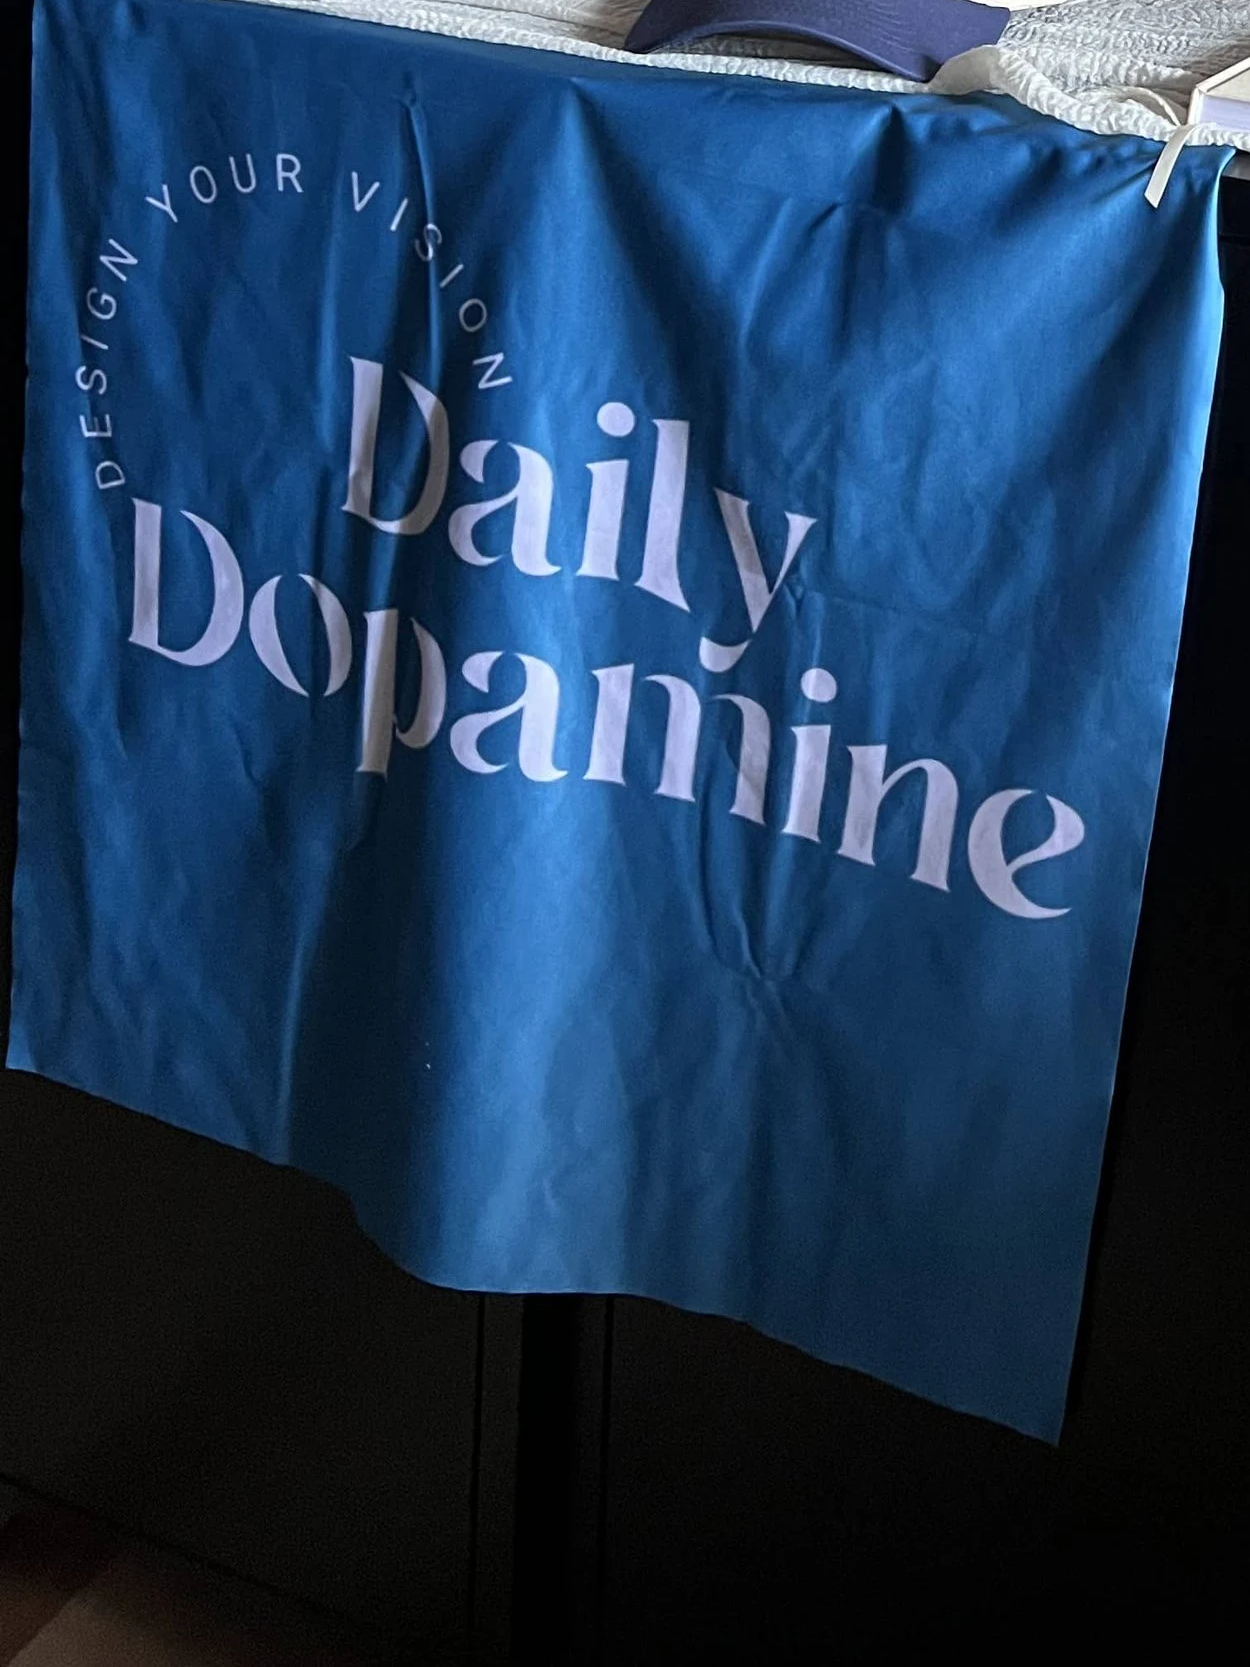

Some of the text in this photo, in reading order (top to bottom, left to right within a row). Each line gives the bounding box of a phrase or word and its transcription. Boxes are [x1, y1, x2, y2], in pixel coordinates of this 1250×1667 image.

[75, 153, 513, 490] DESIGN YOUR VISION
[343, 354, 817, 674] Daily
[127, 496, 1086, 919] Dopamine
